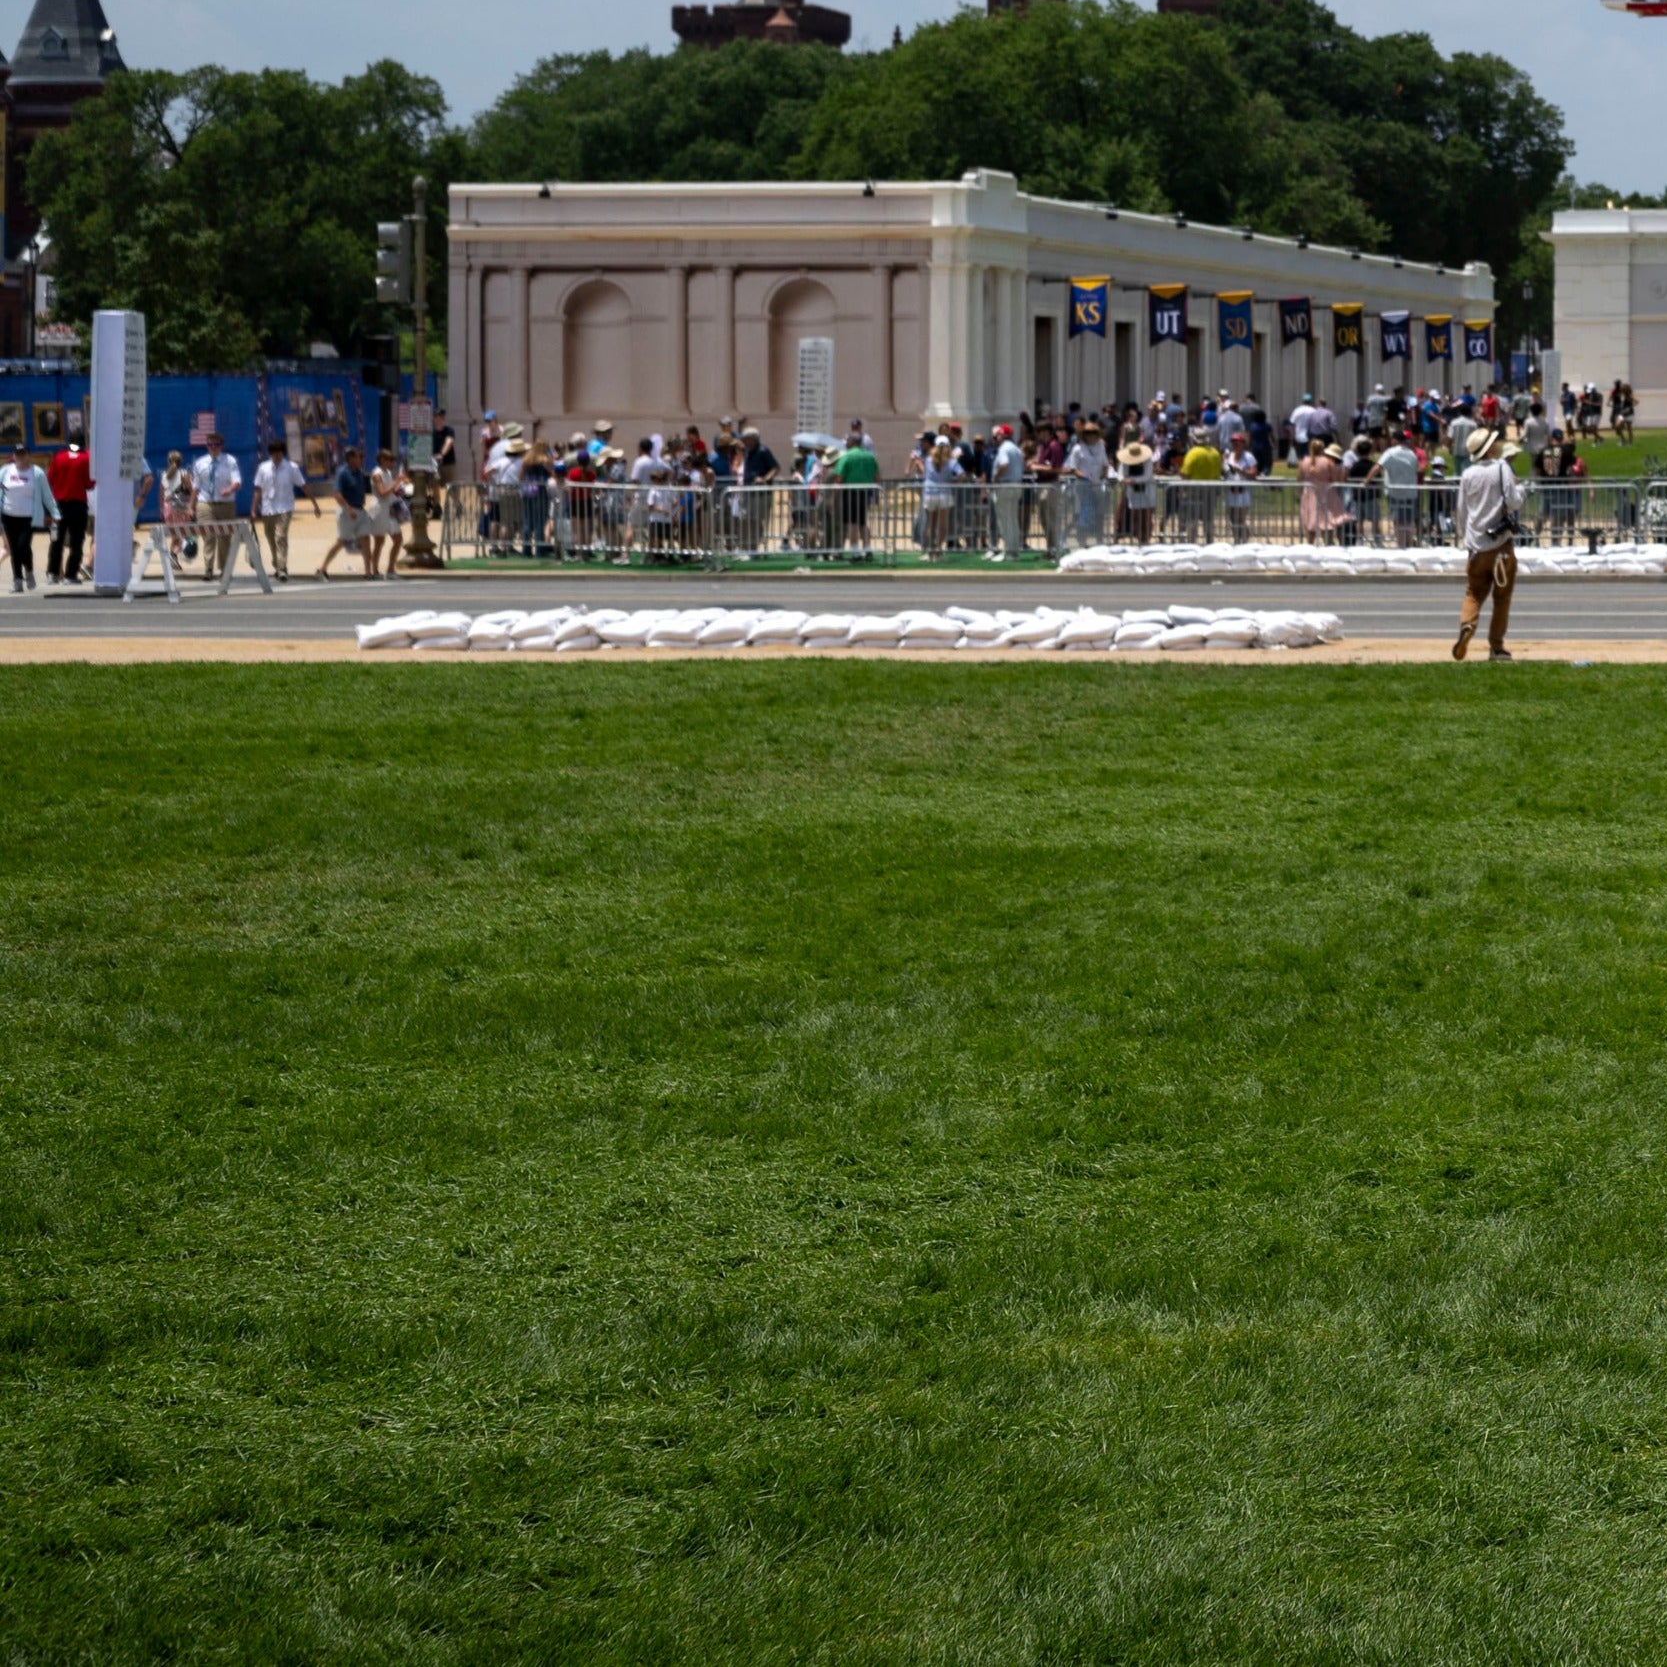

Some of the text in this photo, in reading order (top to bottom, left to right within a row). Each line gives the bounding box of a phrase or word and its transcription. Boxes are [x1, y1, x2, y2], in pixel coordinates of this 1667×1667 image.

[1075, 301, 1101, 325] KS
[1156, 310, 1180, 335] UT
[1225, 317, 1247, 340] SD
[1284, 313, 1309, 335] ND
[1337, 326, 1359, 347] OR
[1384, 333, 1407, 353] WY
[1430, 334, 1448, 354] NE
[1468, 338, 1488, 357] CO
